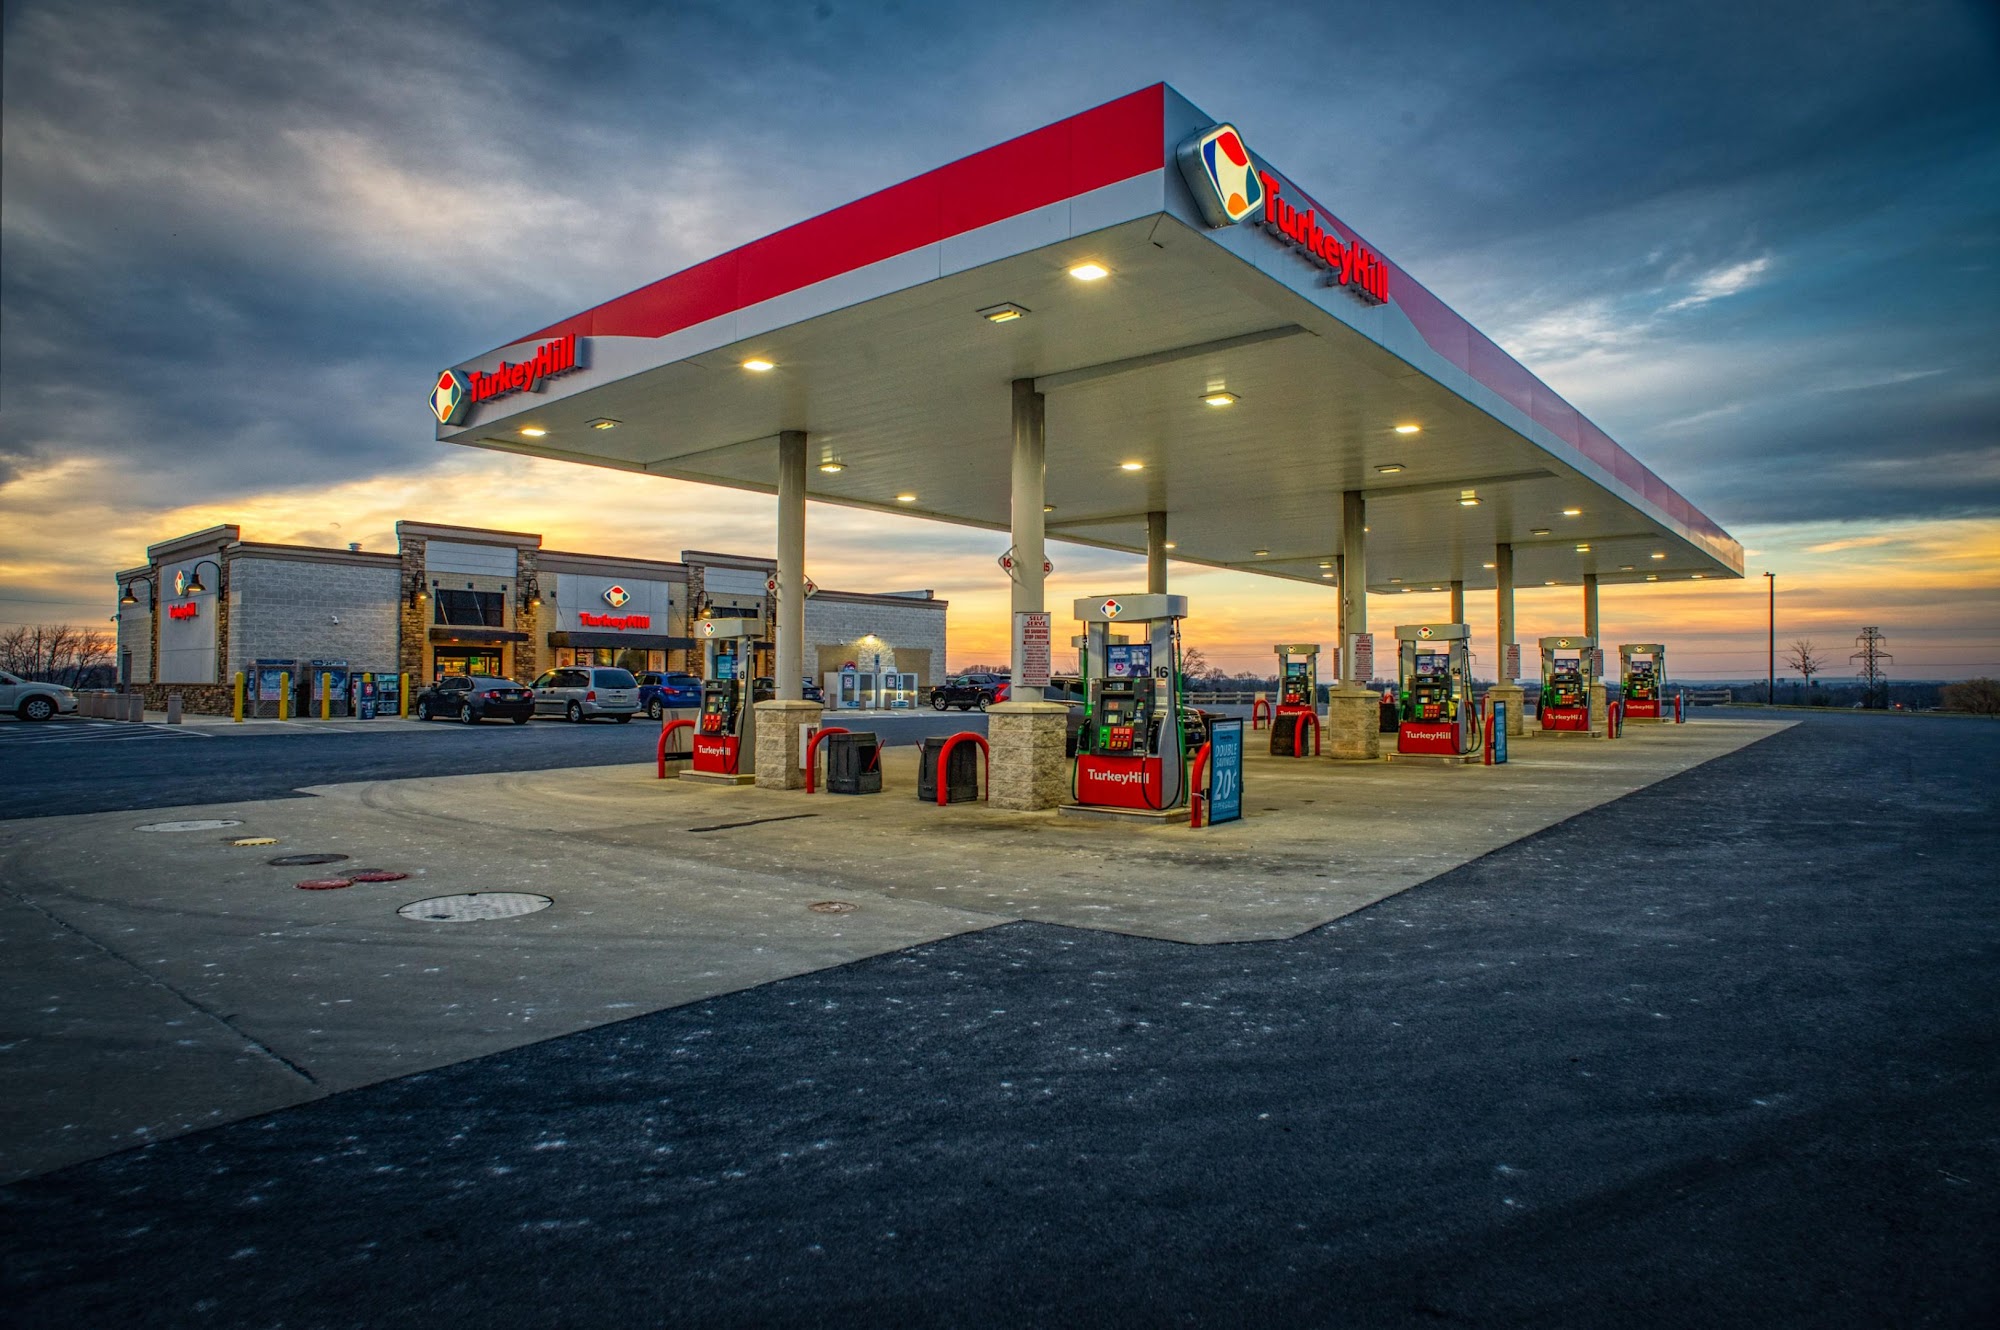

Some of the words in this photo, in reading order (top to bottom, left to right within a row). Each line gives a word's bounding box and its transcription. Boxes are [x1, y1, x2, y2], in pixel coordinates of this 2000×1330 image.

[1003, 557, 1012, 568] 16
[768, 580, 776, 590] 8
[806, 583, 813, 592] 7
[740, 671, 745, 680] 8
[1154, 666, 1168, 678] 16
[1451, 667, 1461, 675] 14
[1215, 743, 1238, 758] DOUBLE
